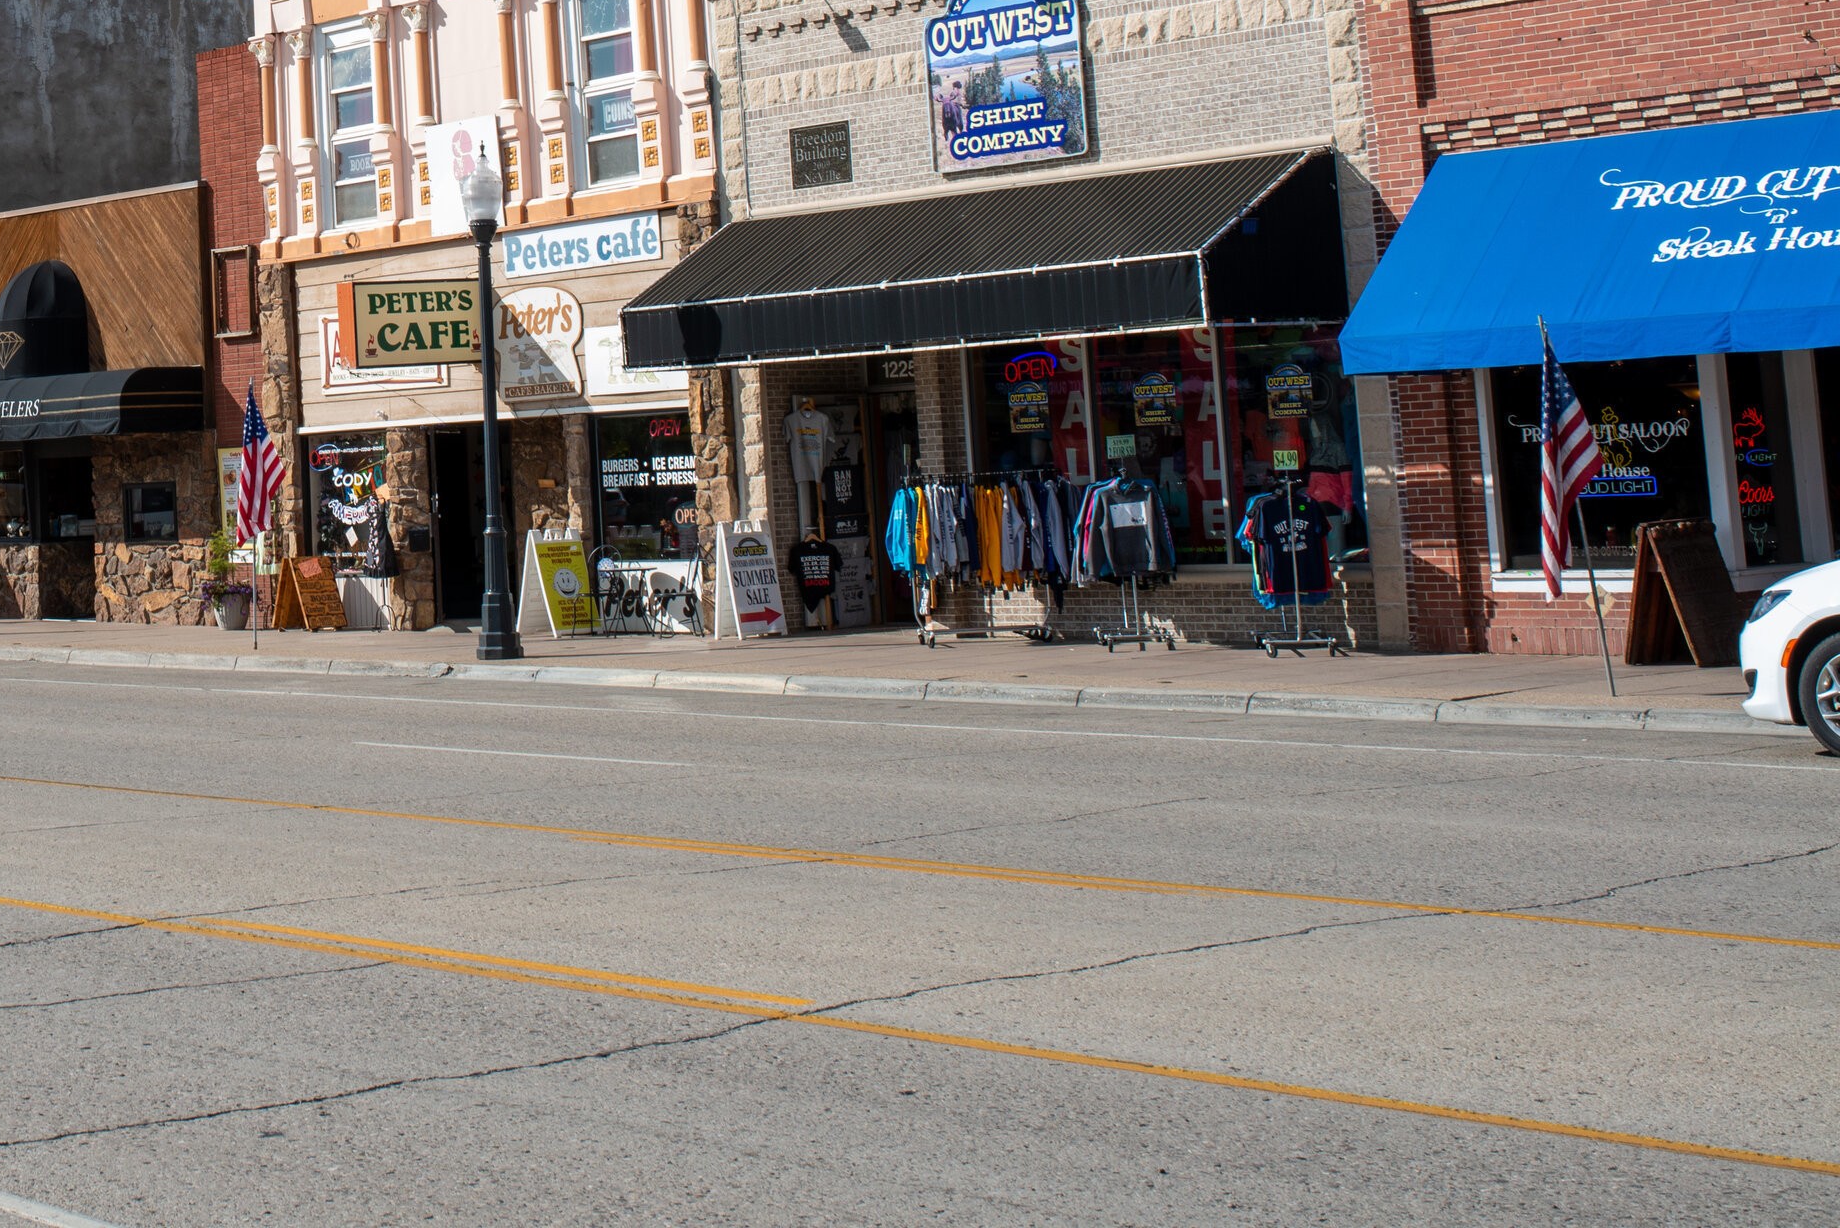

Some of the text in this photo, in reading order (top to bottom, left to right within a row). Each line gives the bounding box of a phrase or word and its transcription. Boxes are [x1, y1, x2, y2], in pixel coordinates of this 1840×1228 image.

[931, 0, 1071, 53] OUT WEST
[602, 104, 634, 123] COINS
[969, 102, 1044, 129] SHIRT
[793, 129, 846, 148] Freedom
[953, 124, 1064, 156] COMPANY
[794, 144, 847, 162] Building
[350, 158, 375, 172] BOOK
[1601, 166, 1840, 209] PROUD CUT
[504, 216, 658, 272] Peters café
[1652, 226, 1840, 263] Steak Hou
[367, 290, 473, 315] PETER'S
[498, 293, 572, 340] Peter's
[377, 320, 471, 352] CAFE
[882, 361, 915, 379] 1225
[1005, 358, 1055, 383] OPEN
[509, 381, 572, 397] CAFE BAKERY
[1134, 384, 1174, 395] OUT WEST
[1267, 376, 1310, 387] OUT WEST
[1010, 393, 1046, 403] OUT WEST
[649, 420, 681, 437] OPEN
[309, 450, 339, 467] OPEN
[602, 458, 639, 473] BURGERS
[652, 457, 666, 470] ICE
[1275, 452, 1298, 467] $4.99
[1751, 453, 1778, 462] LIGHT
[834, 470, 852, 480] BAN
[1602, 463, 1651, 478] House
[334, 472, 373, 487] CODY
[602, 472, 650, 487] BREAKFAST
[1580, 480, 1653, 495] BUD LIGHT
[835, 485, 853, 493] NOT
[1739, 480, 1775, 504] Coors
[1273, 518, 1309, 534] OUT EST
[733, 545, 768, 557] OUT WEST
[733, 568, 778, 588] SUMMER
[605, 575, 698, 618] Peter's
[746, 588, 771, 606] SALE
